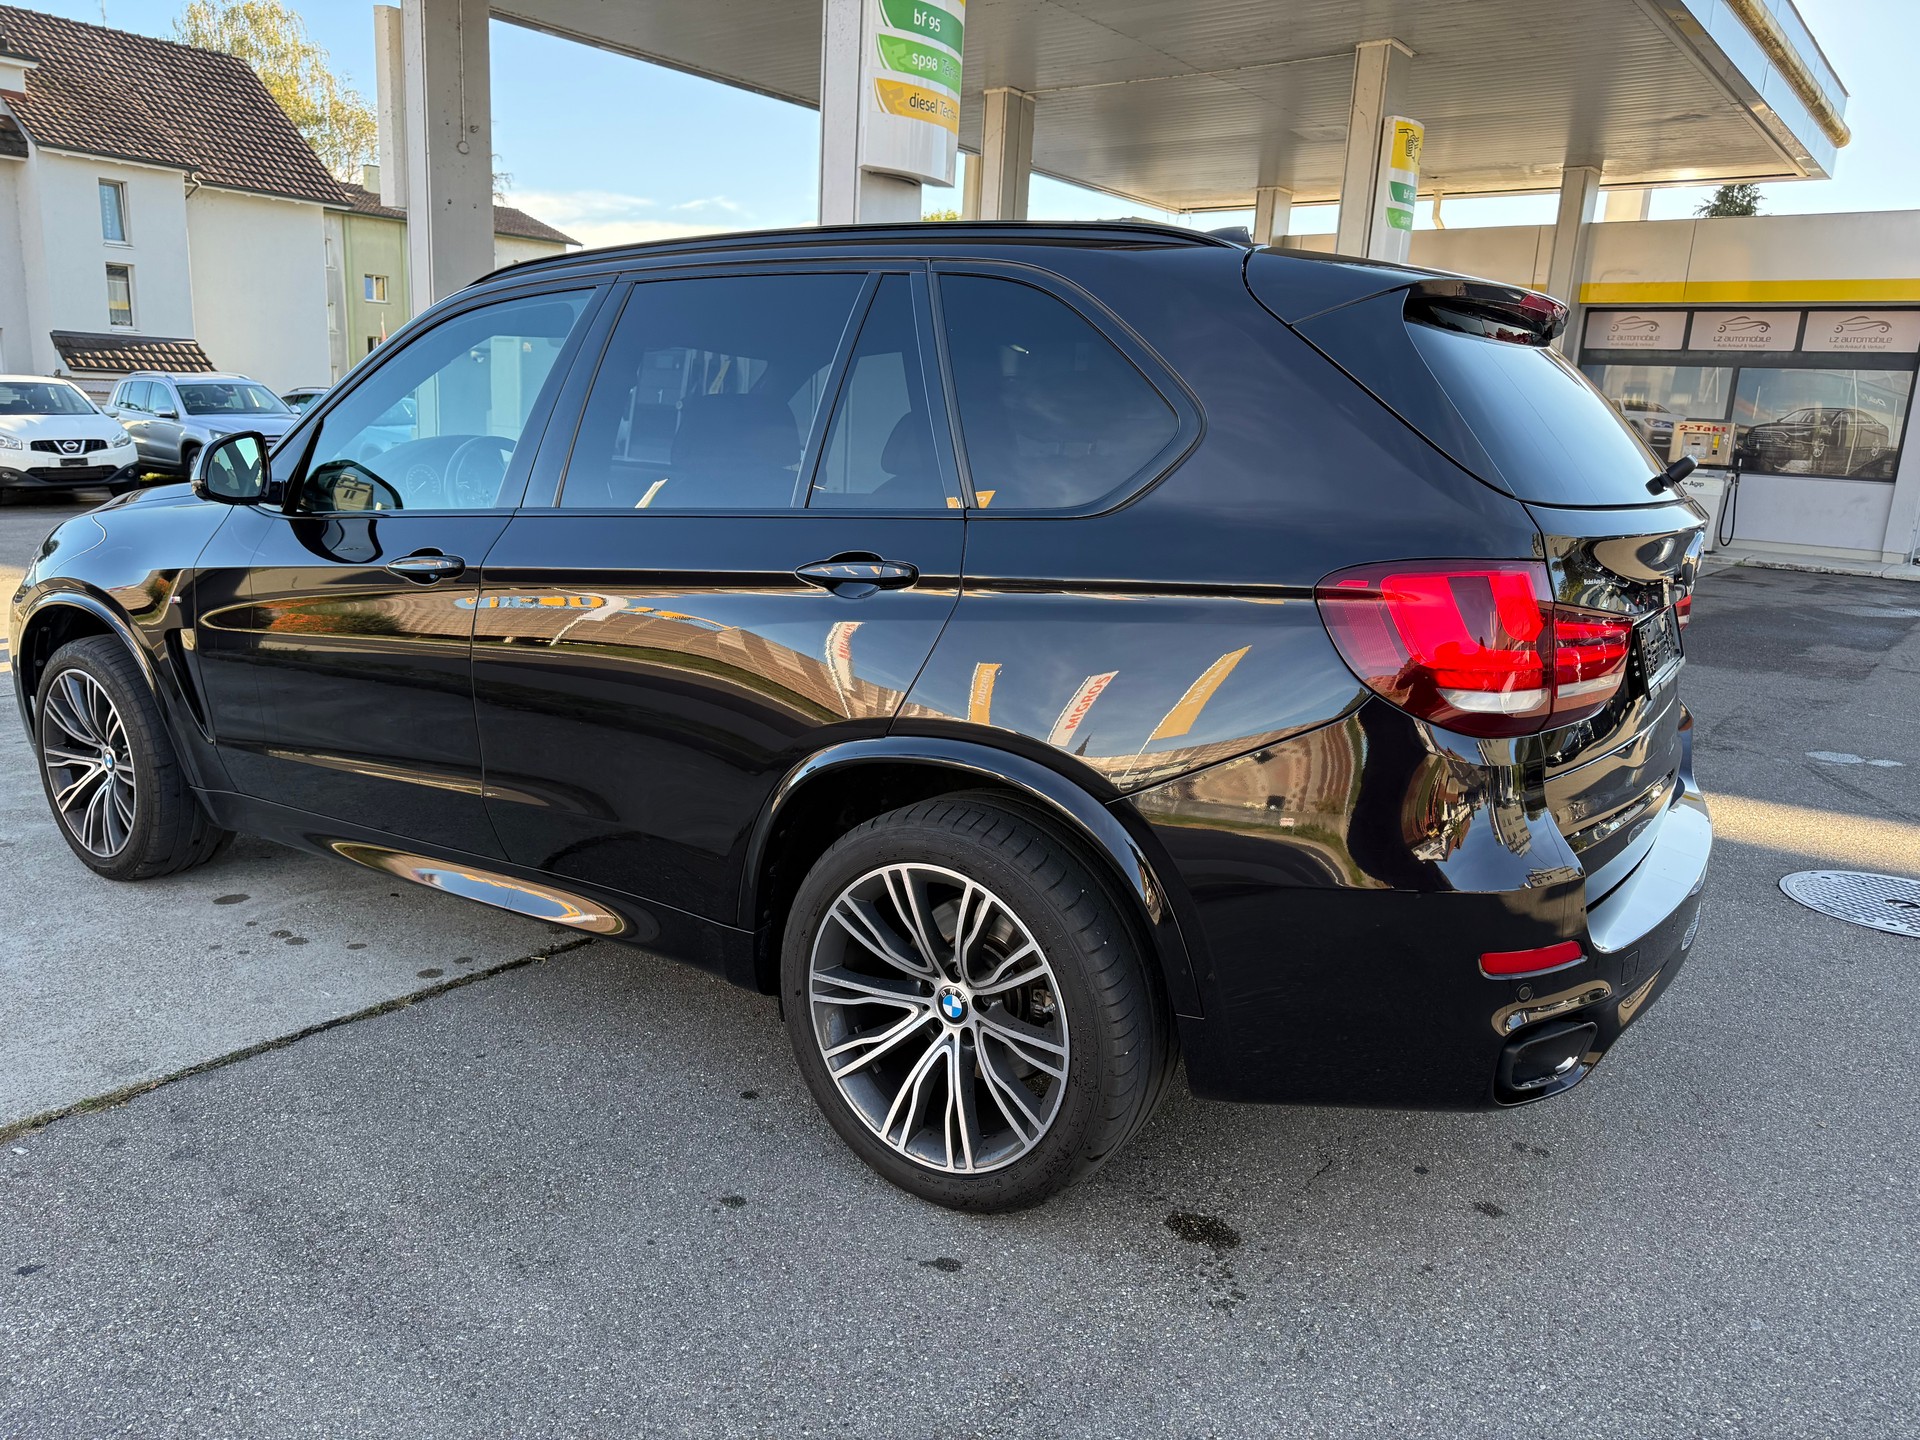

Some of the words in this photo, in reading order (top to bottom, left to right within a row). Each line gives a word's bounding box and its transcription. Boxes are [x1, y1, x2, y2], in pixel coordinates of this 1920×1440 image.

[914, 8, 927, 27] bf
[928, 16, 941, 32] 95
[912, 53, 938, 71] sp98
[909, 92, 938, 114] diesel
[1679, 424, 1727, 432] 2-Takt
[1064, 675, 1111, 730] MIGROS
[940, 988, 968, 1003] BMW
